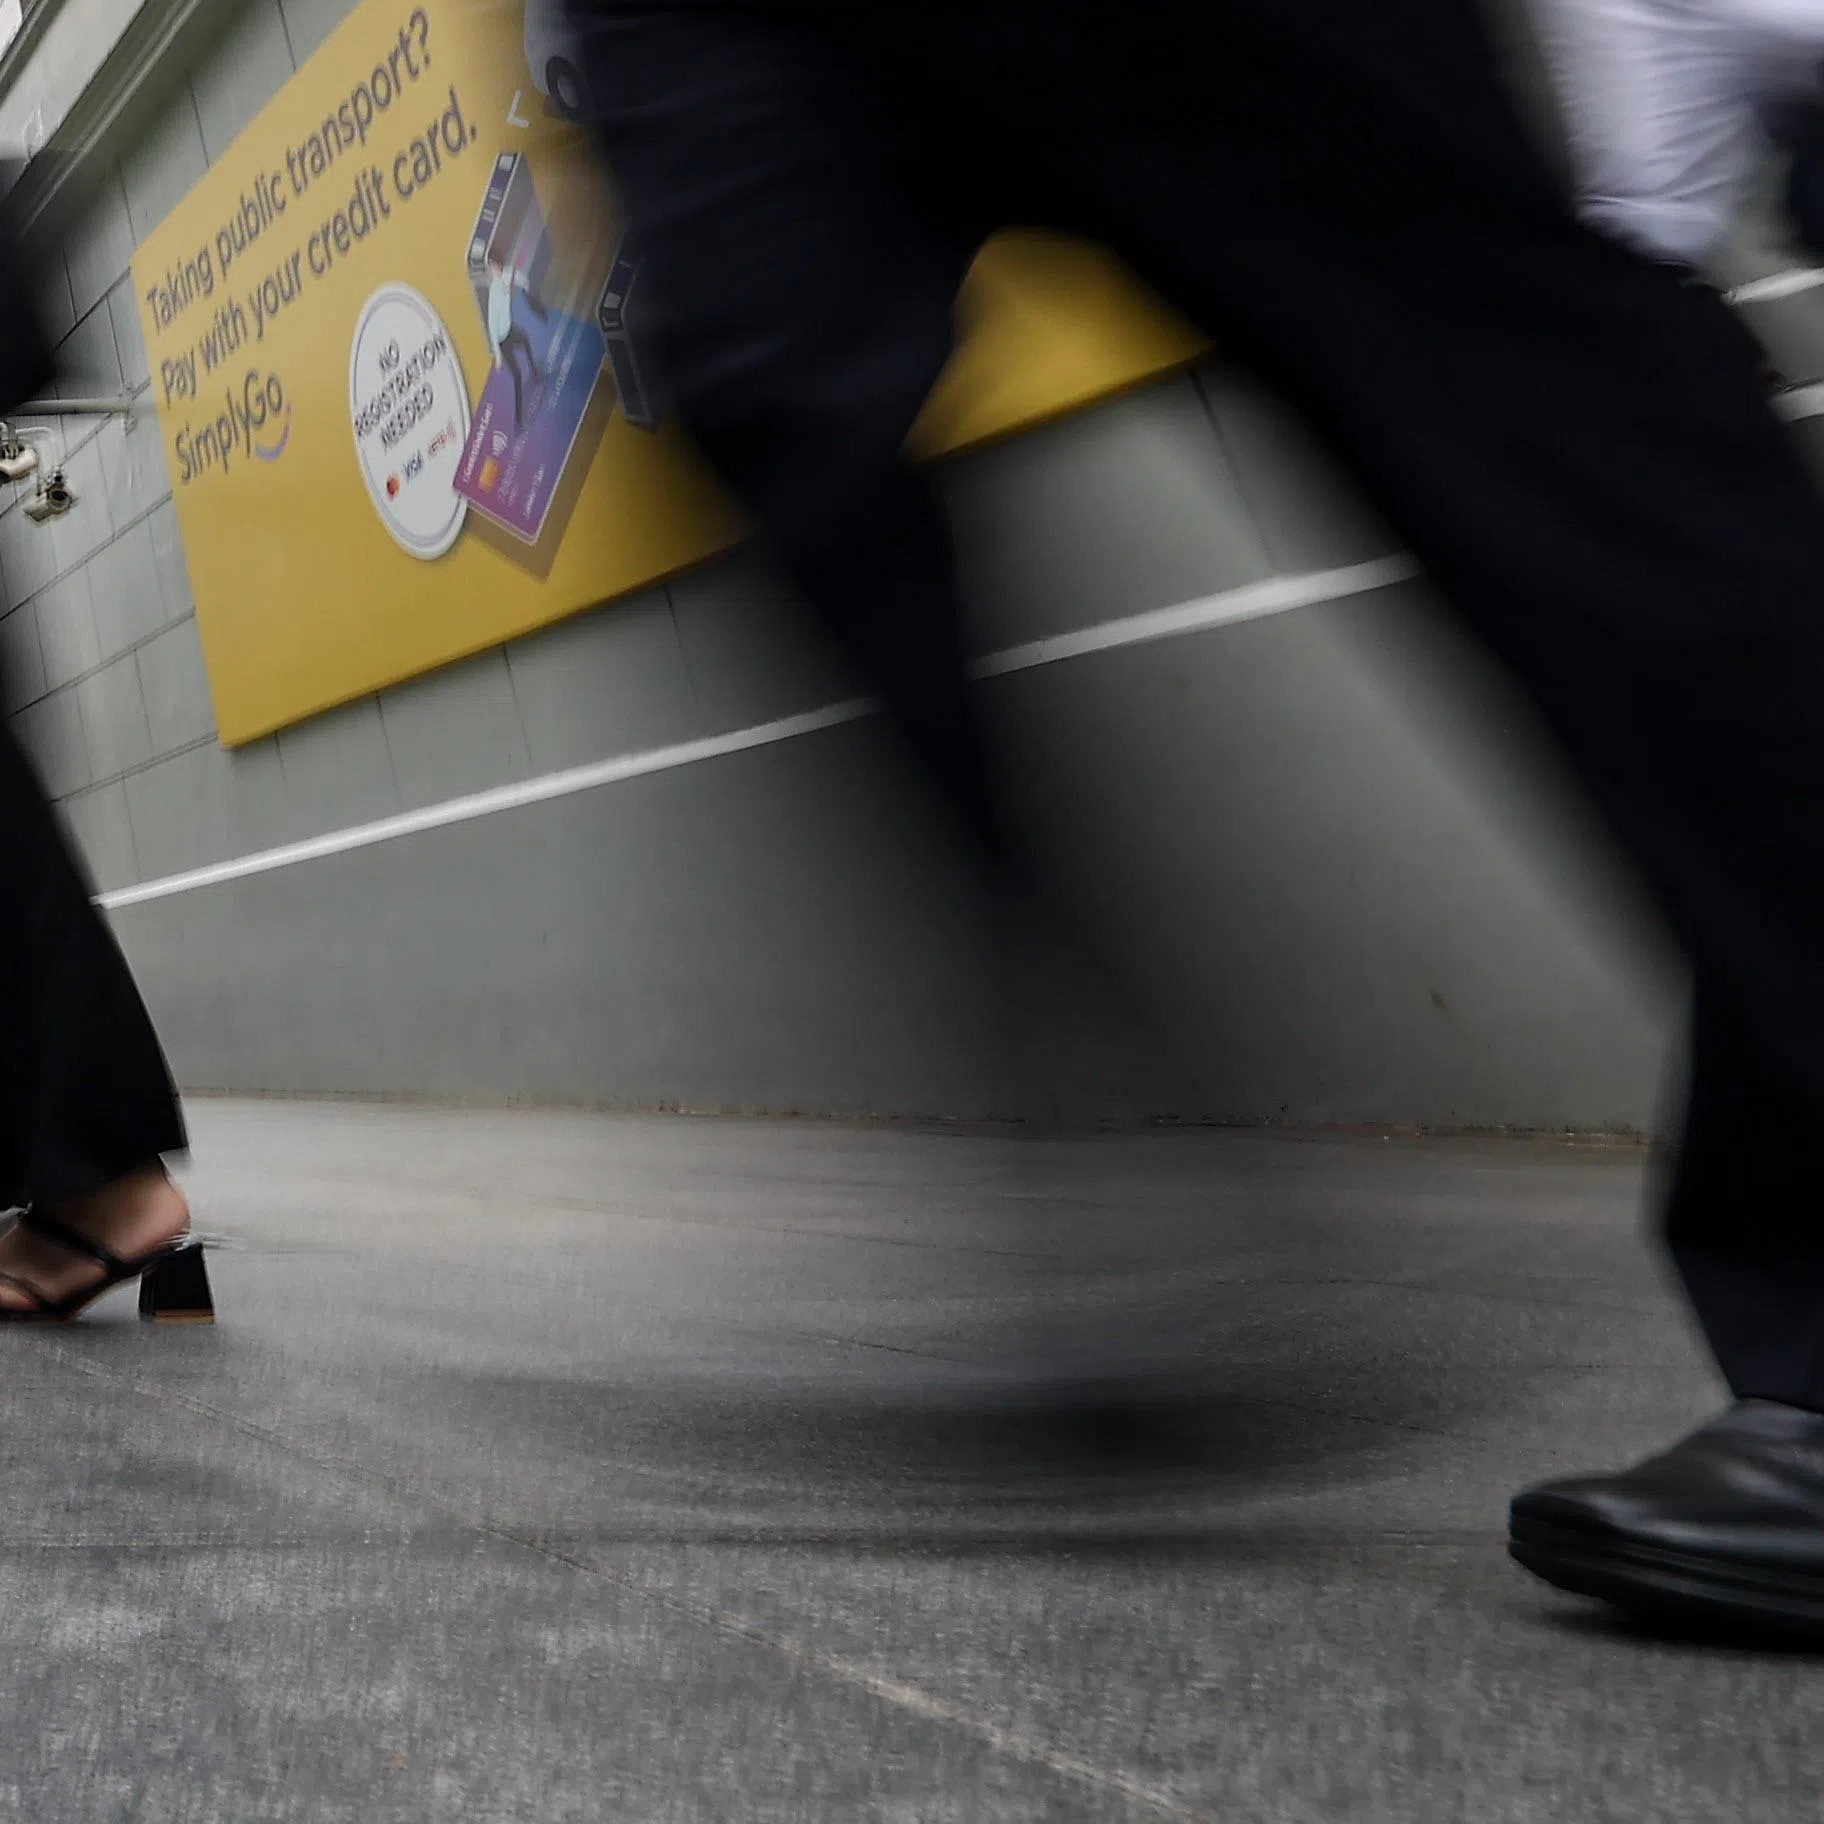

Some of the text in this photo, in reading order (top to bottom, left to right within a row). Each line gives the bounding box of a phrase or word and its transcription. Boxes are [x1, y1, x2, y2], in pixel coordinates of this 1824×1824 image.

[146, 5, 432, 336] Taking public transport?
[160, 83, 478, 409] Pay with your credit card.
[354, 329, 448, 444] REGISTRATION
[378, 338, 401, 375] NO
[176, 368, 284, 487] SimplyGo
[379, 381, 435, 455] NEEDED
